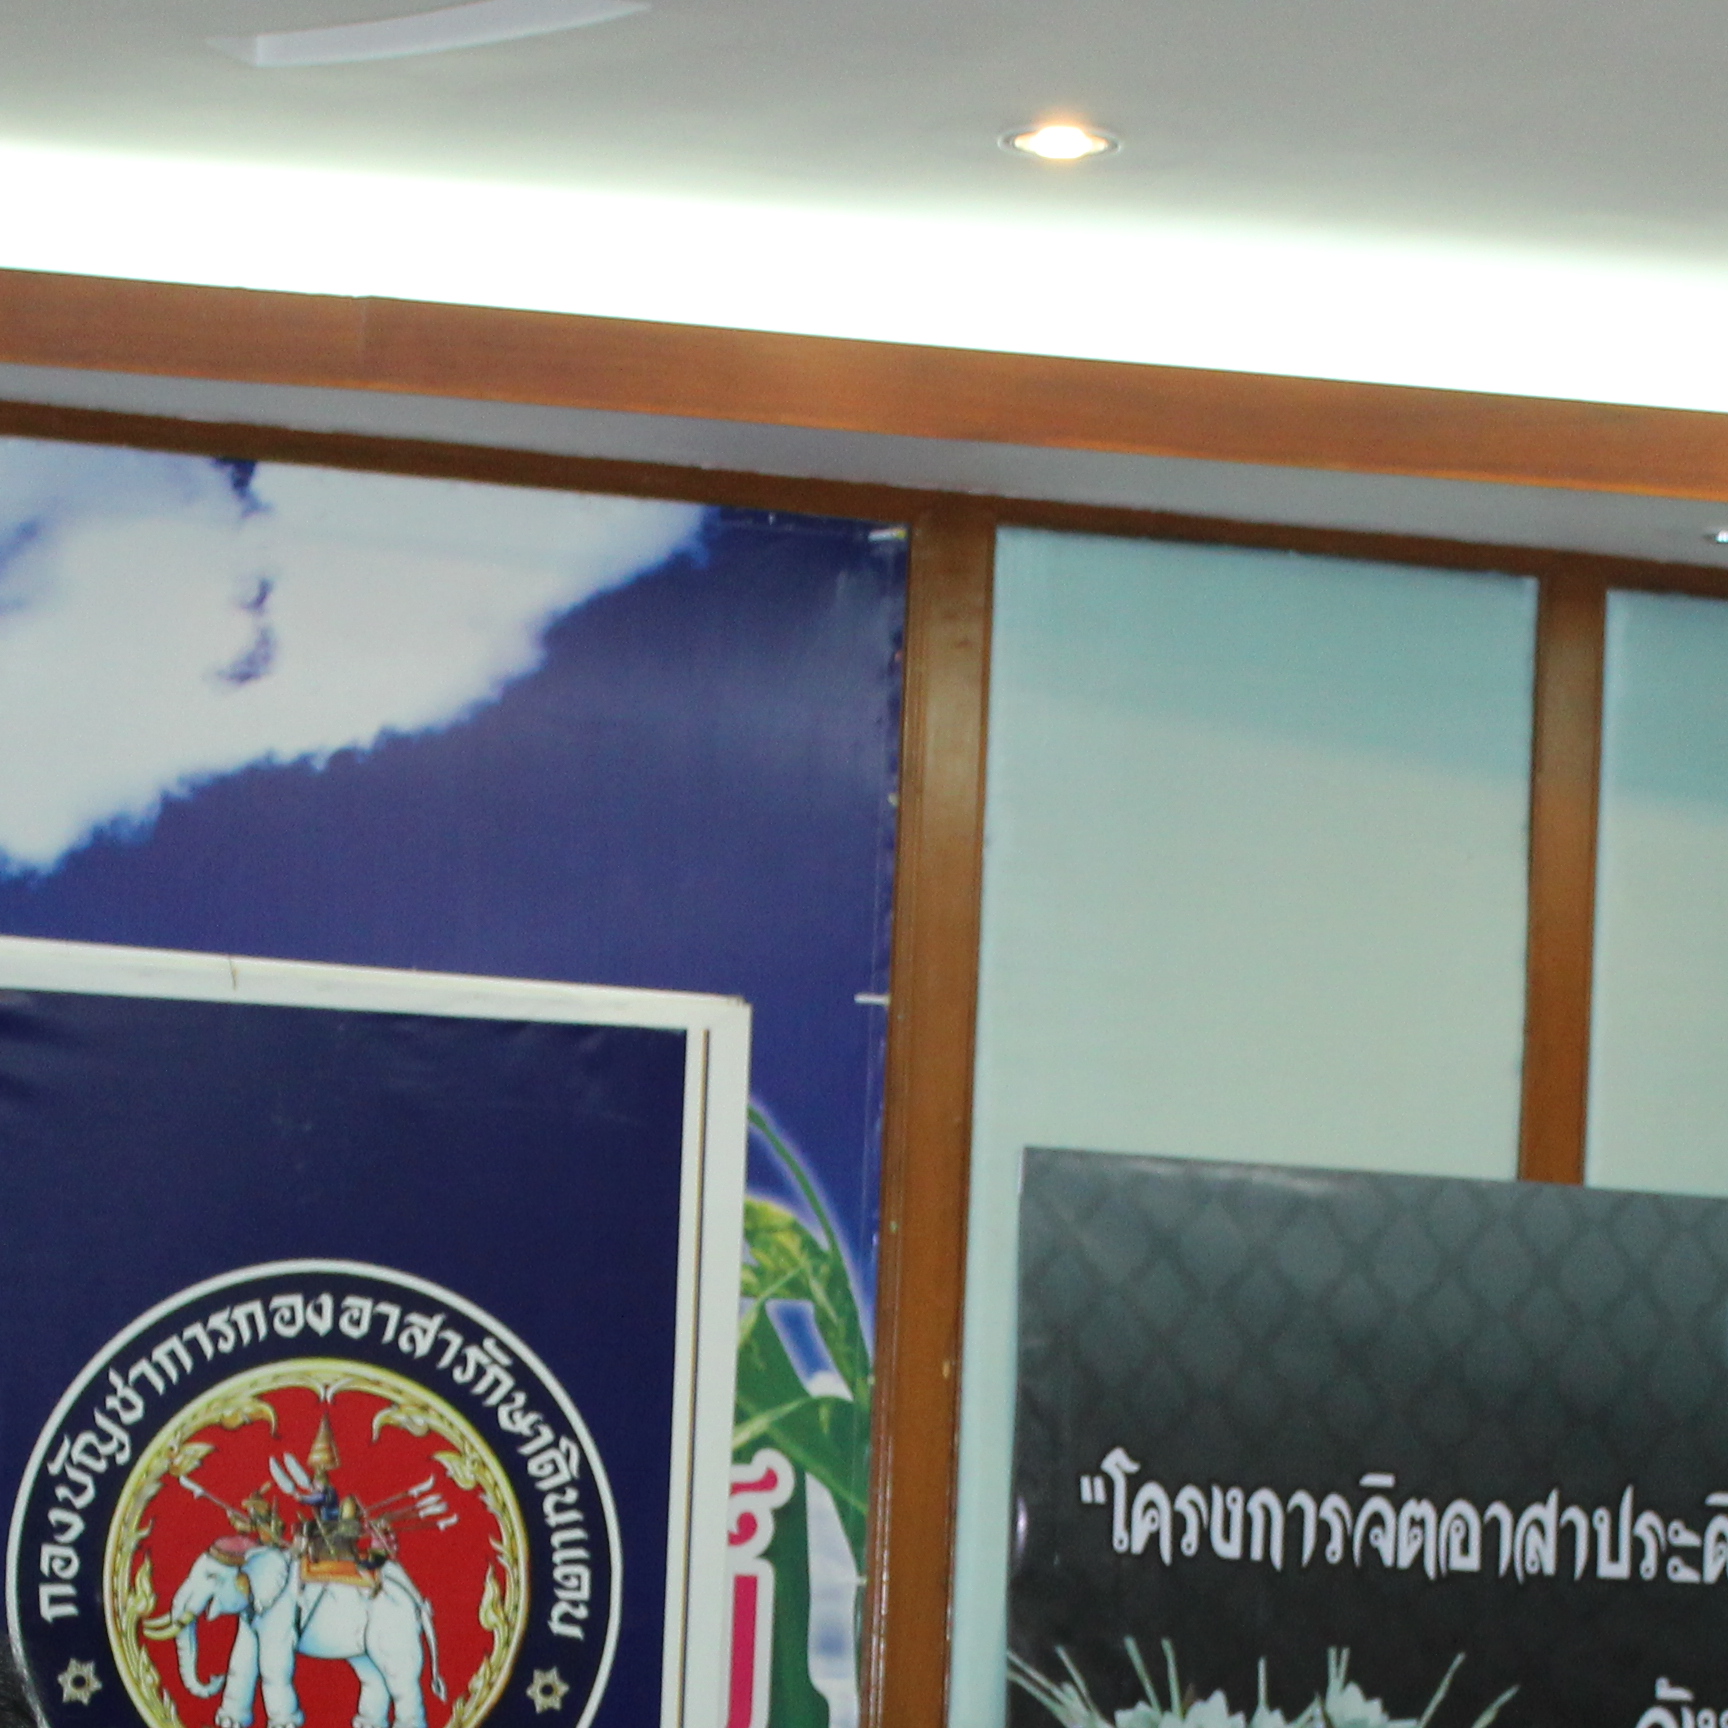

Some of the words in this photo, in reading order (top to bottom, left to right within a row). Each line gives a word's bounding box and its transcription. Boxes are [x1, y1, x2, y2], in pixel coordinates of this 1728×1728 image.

[39, 1293, 590, 1639] กองบัญชาการกองอาสารักษาดินแดน
